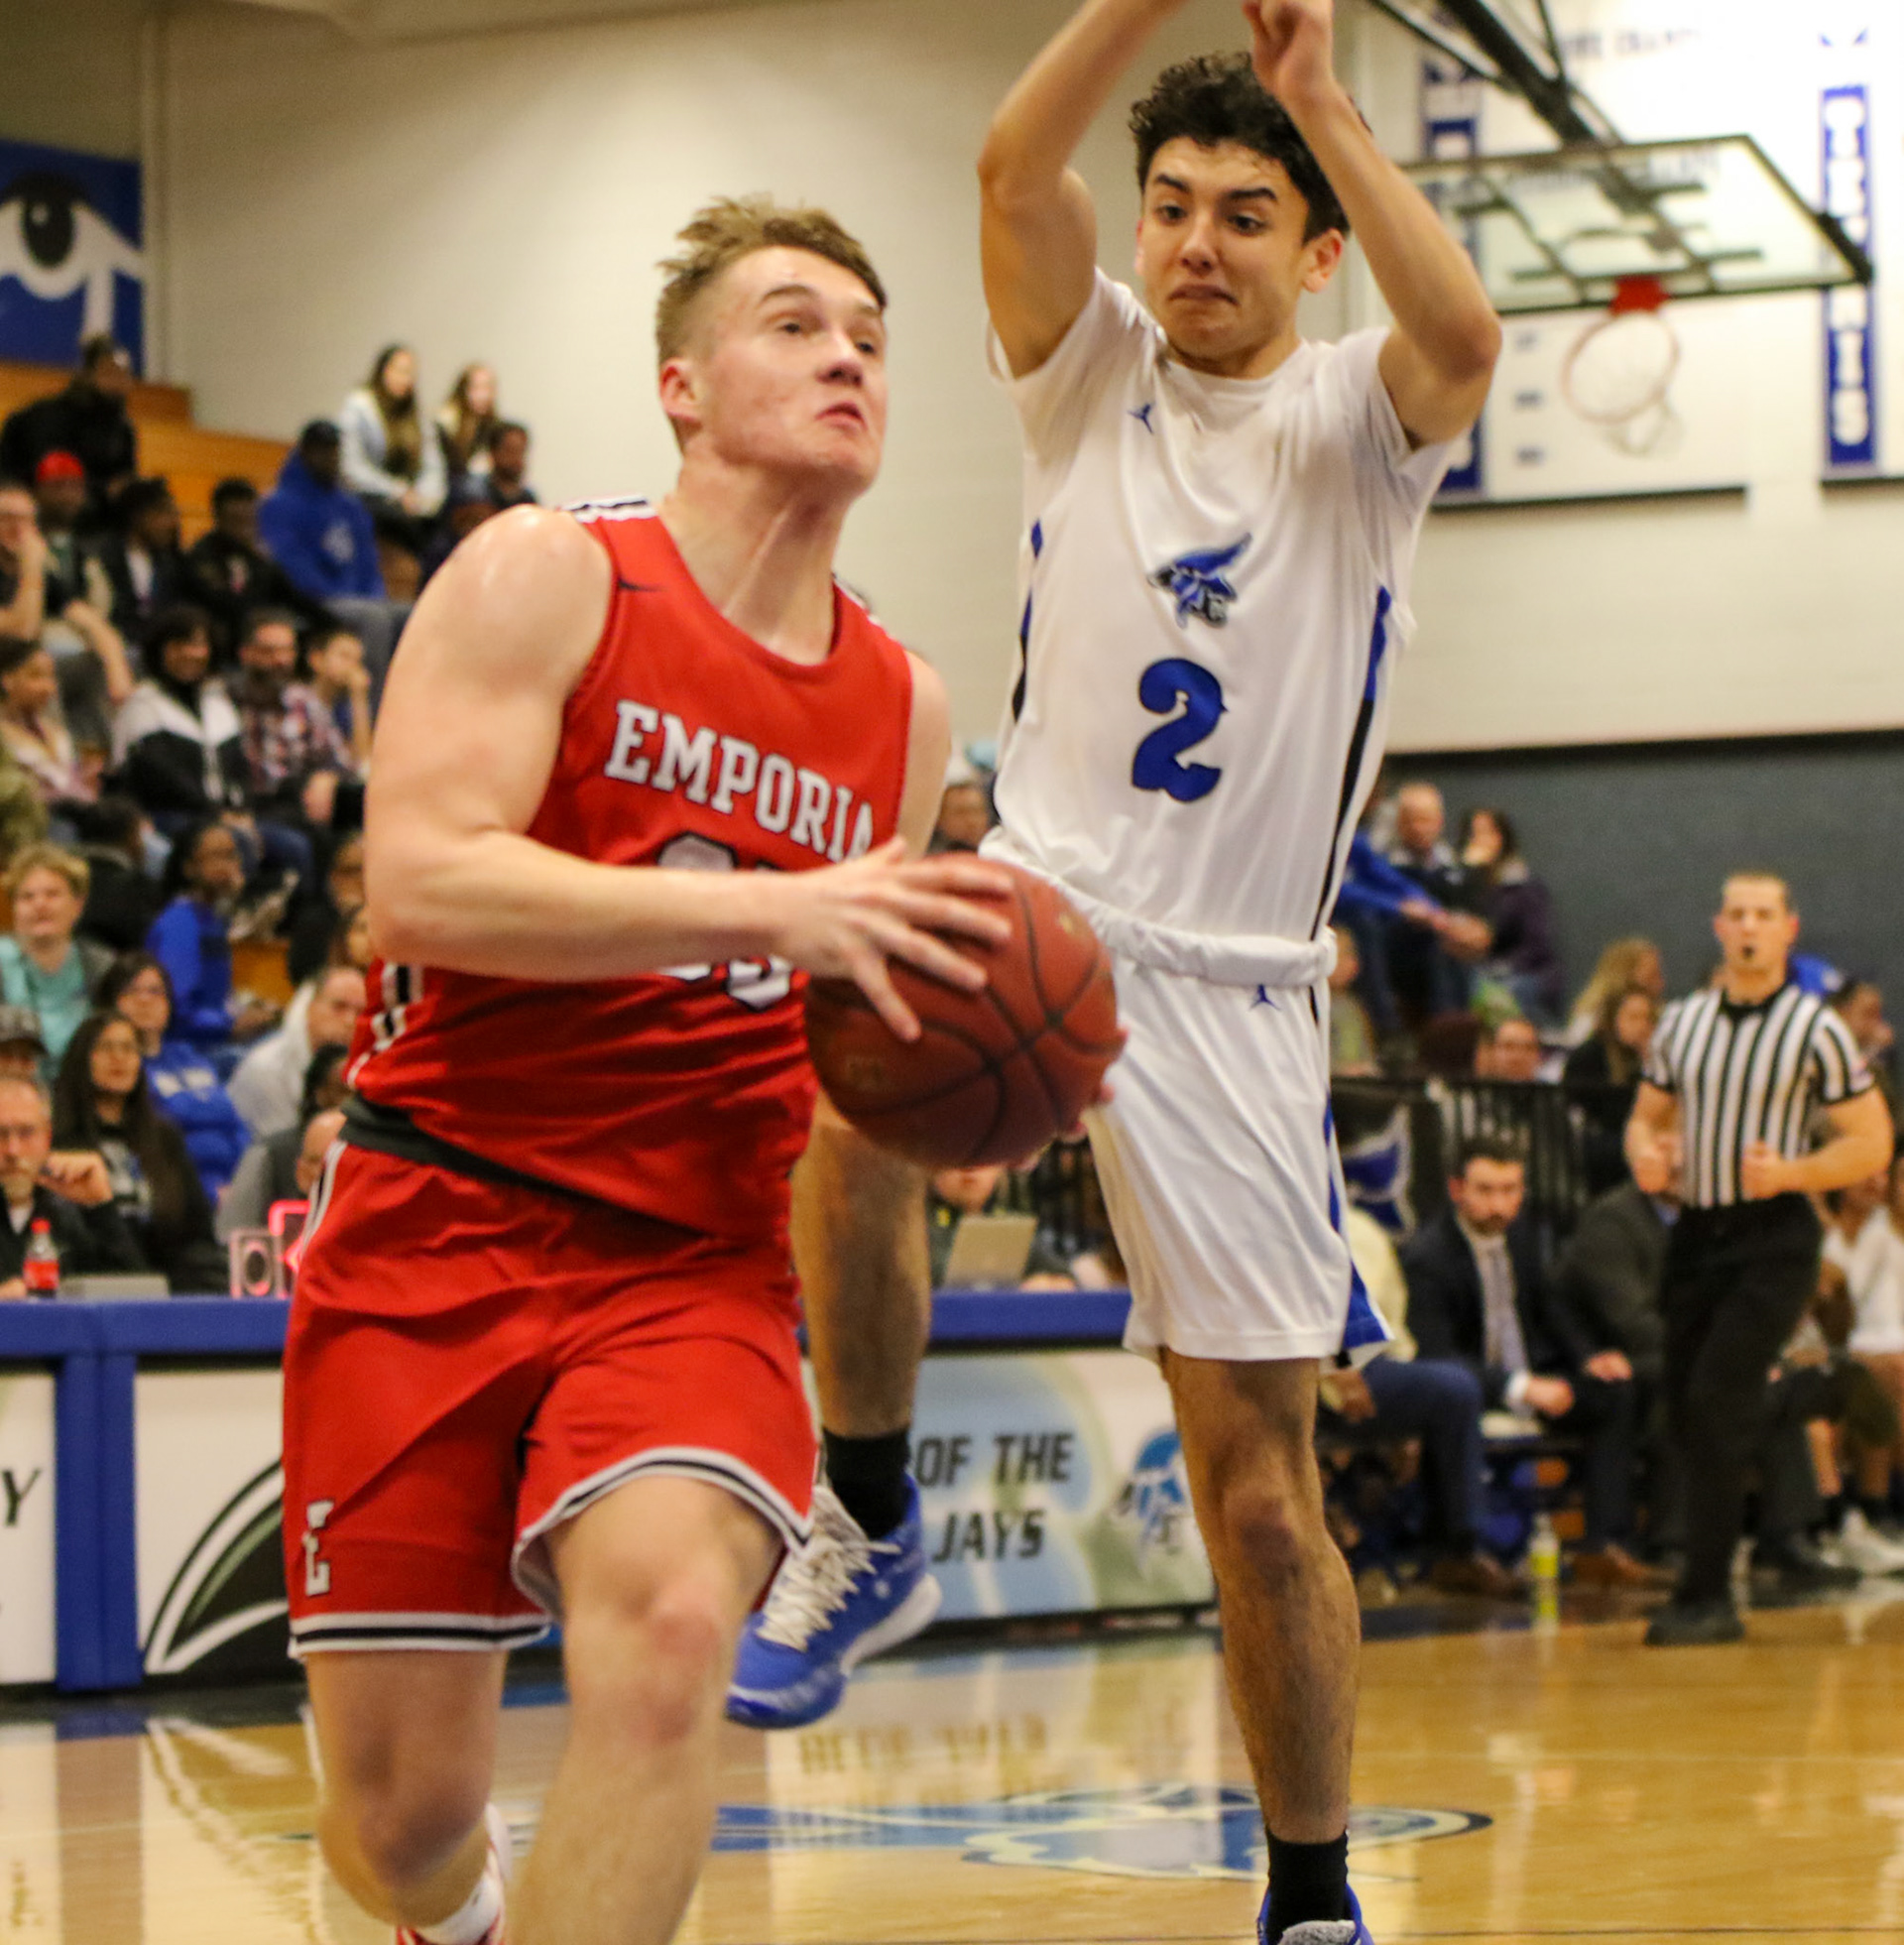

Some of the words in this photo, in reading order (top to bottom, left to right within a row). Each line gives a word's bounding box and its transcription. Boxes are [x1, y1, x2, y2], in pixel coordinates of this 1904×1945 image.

[1131, 658, 1229, 803] 2
[604, 698, 873, 864] EMPORIA
[915, 1436, 969, 1488] OF
[995, 1433, 1072, 1484] THE
[932, 1509, 1045, 1564] JAYS
